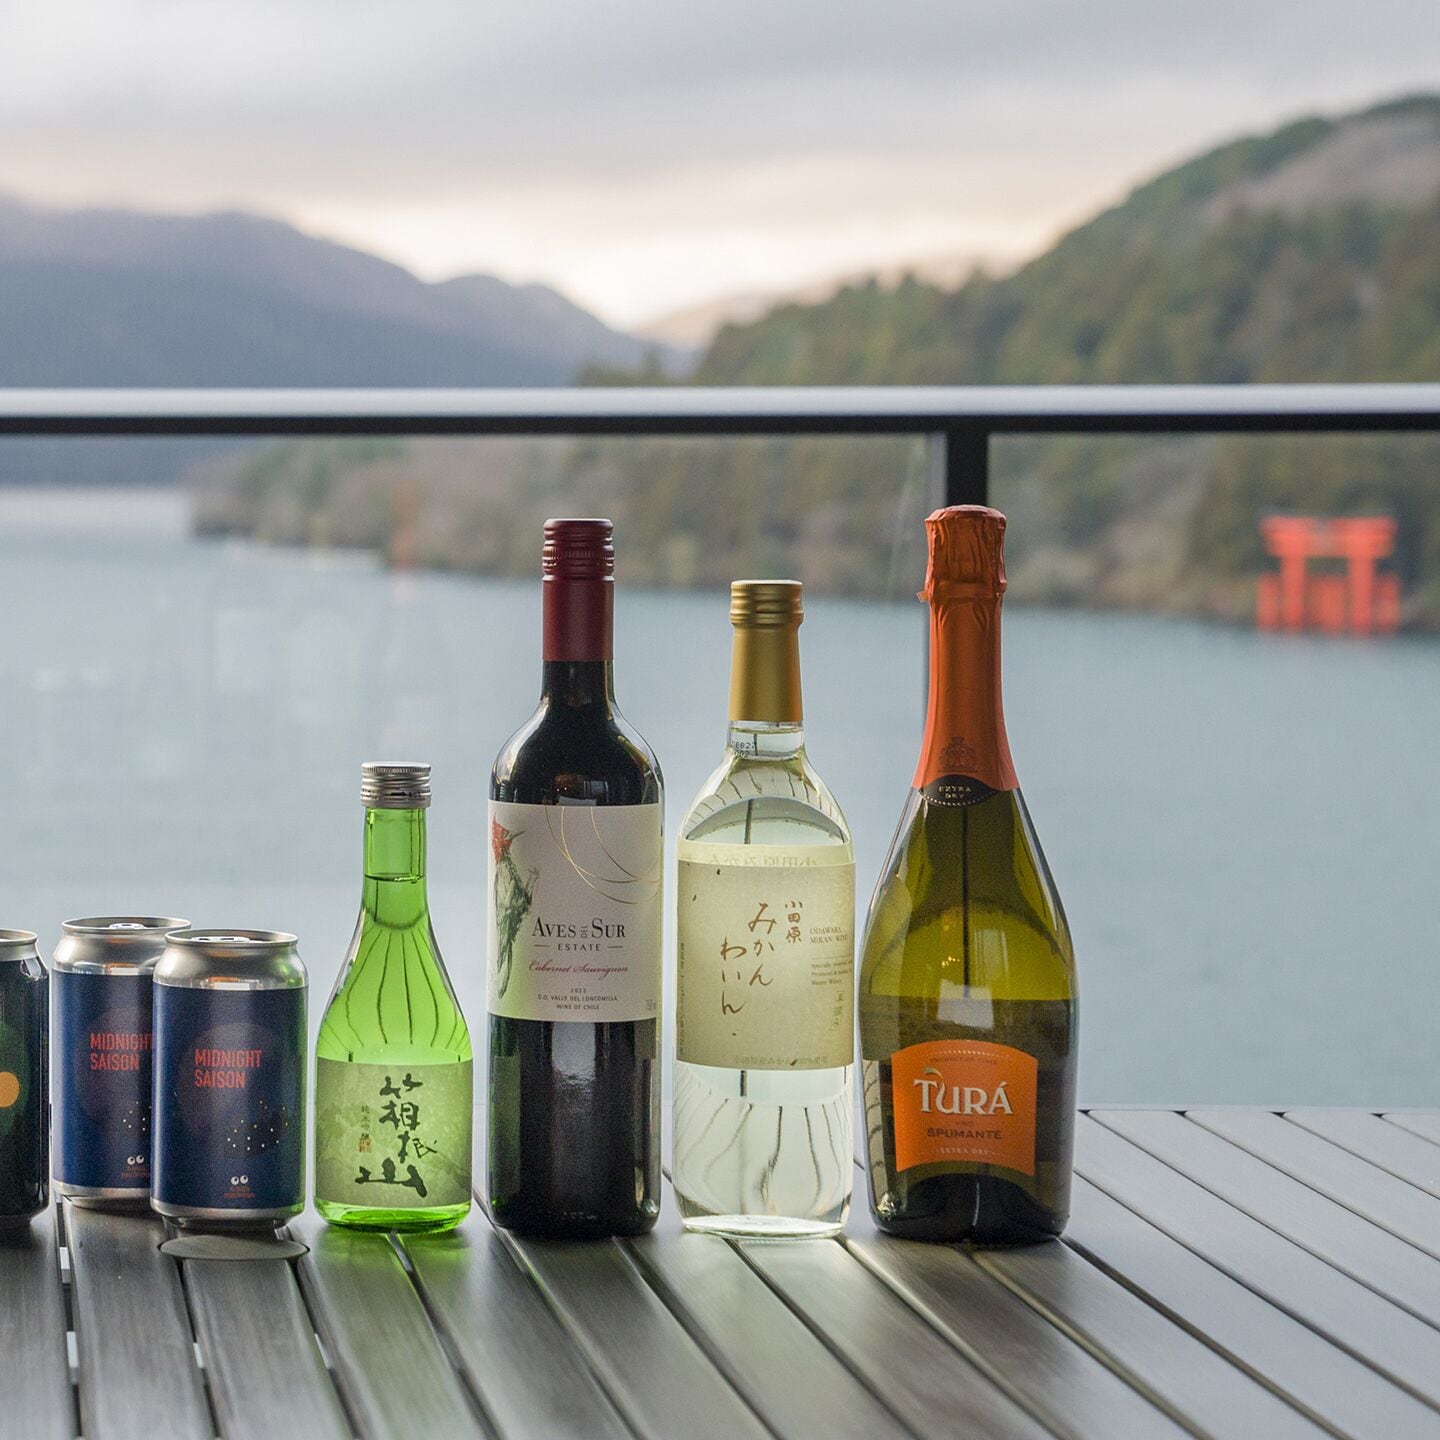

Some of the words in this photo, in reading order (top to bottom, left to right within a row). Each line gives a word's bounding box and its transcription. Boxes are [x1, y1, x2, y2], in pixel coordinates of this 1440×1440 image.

[784, 900, 804, 943] 小田原
[557, 943, 601, 952] ESTATE
[748, 902, 777, 986] みかん
[720, 936, 748, 1015] わいん
[90, 1053, 141, 1071] SAISON
[194, 1049, 263, 1068] MIDNIGHT
[194, 1069, 246, 1088] SAISON
[355, 1073, 437, 1198] 箱根山
[927, 1127, 1003, 1139] SPUMANTE
